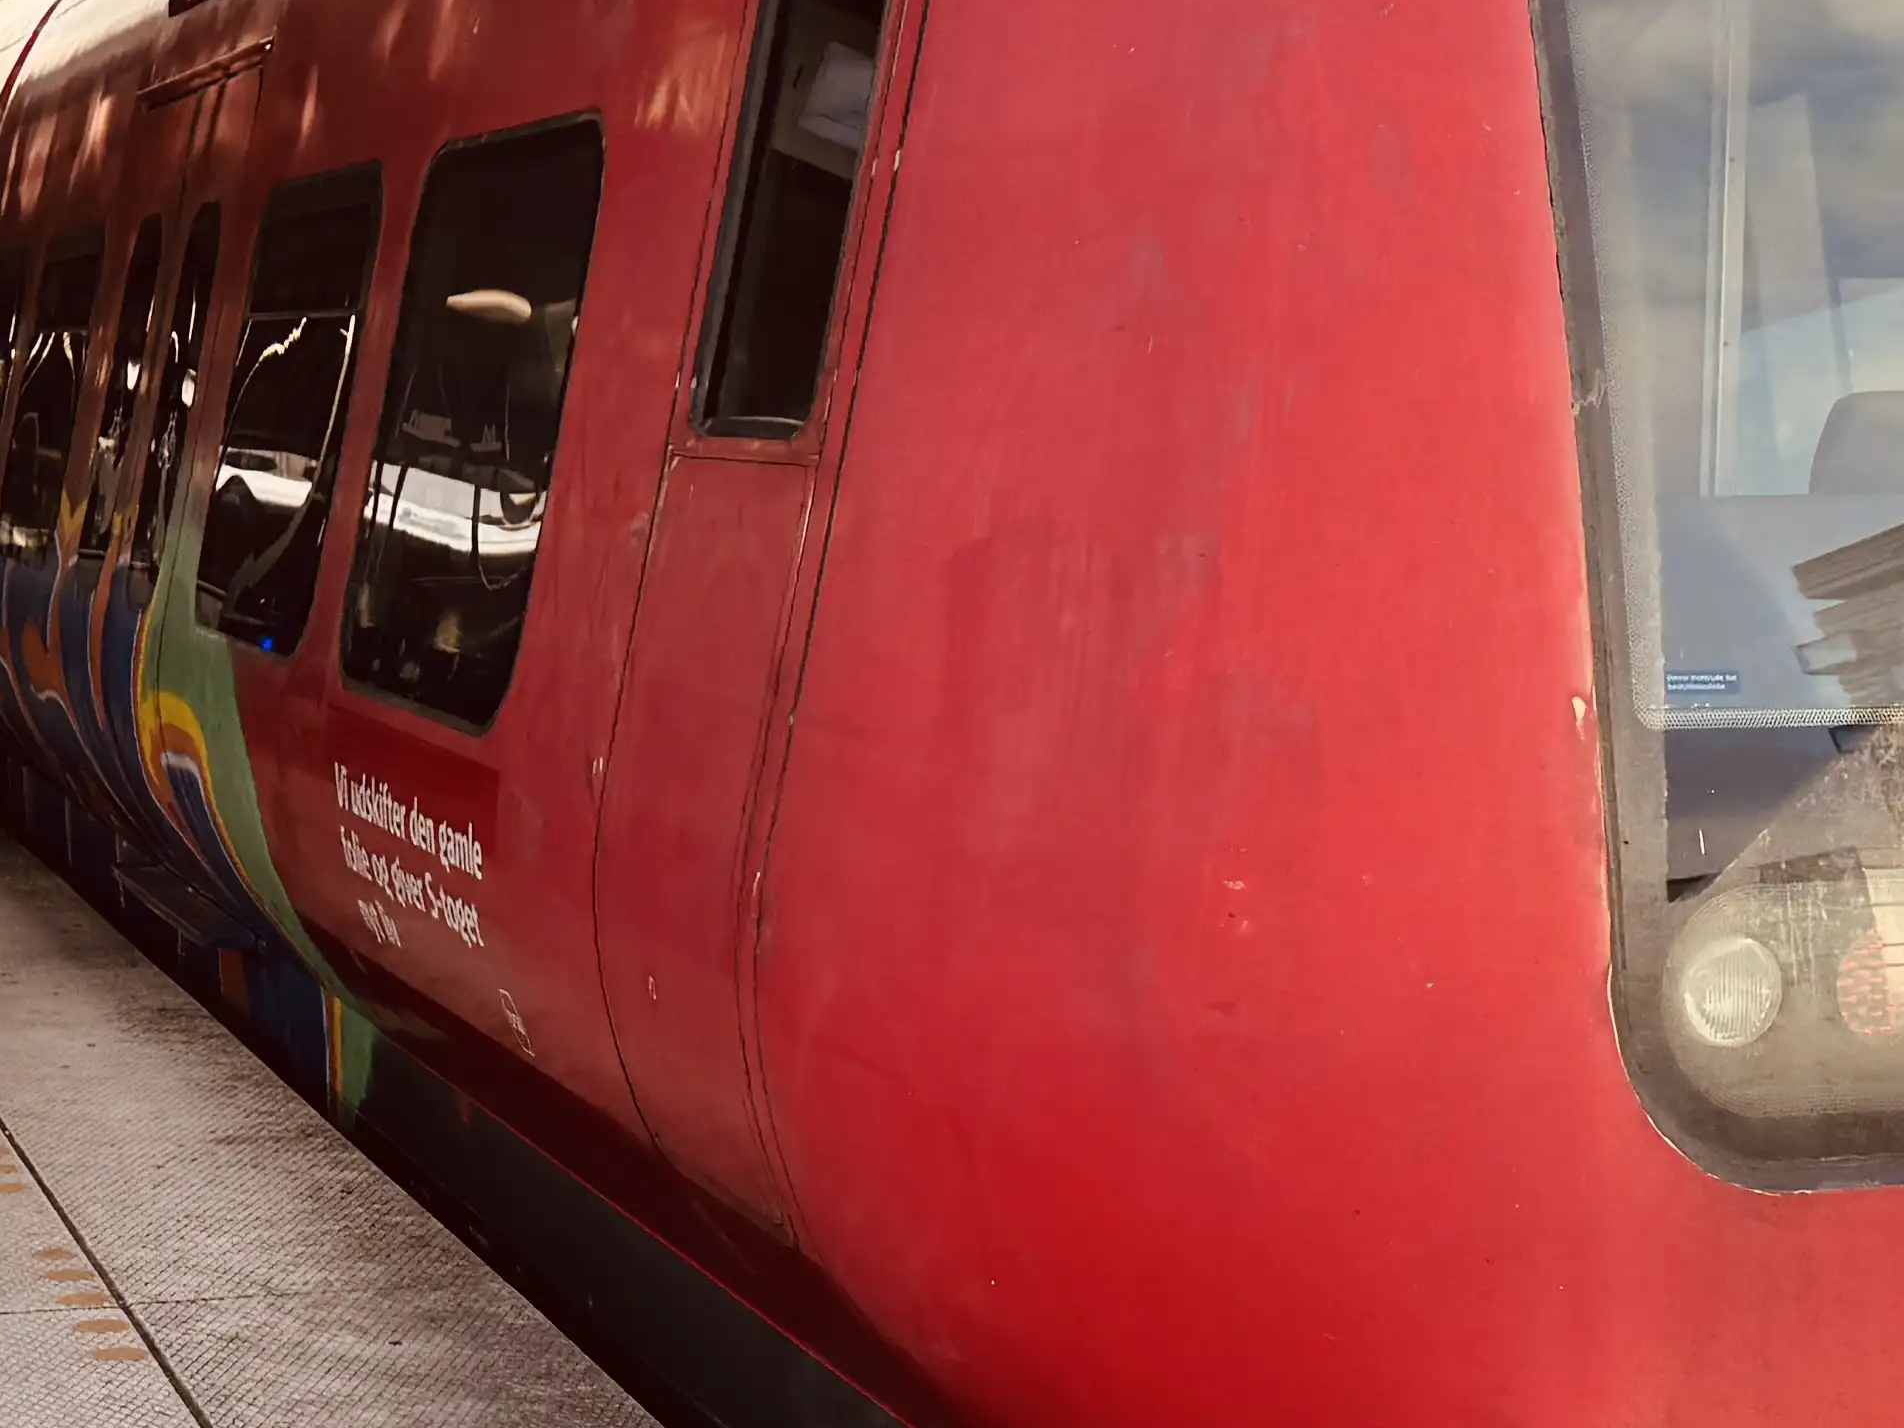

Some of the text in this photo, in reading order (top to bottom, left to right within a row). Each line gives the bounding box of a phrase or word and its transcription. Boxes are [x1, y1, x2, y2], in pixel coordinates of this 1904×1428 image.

[334, 761, 483, 881] Vi udskifter den gamle
[371, 853, 395, 901] og
[391, 855, 427, 913] giver
[425, 872, 485, 949] S-toget
